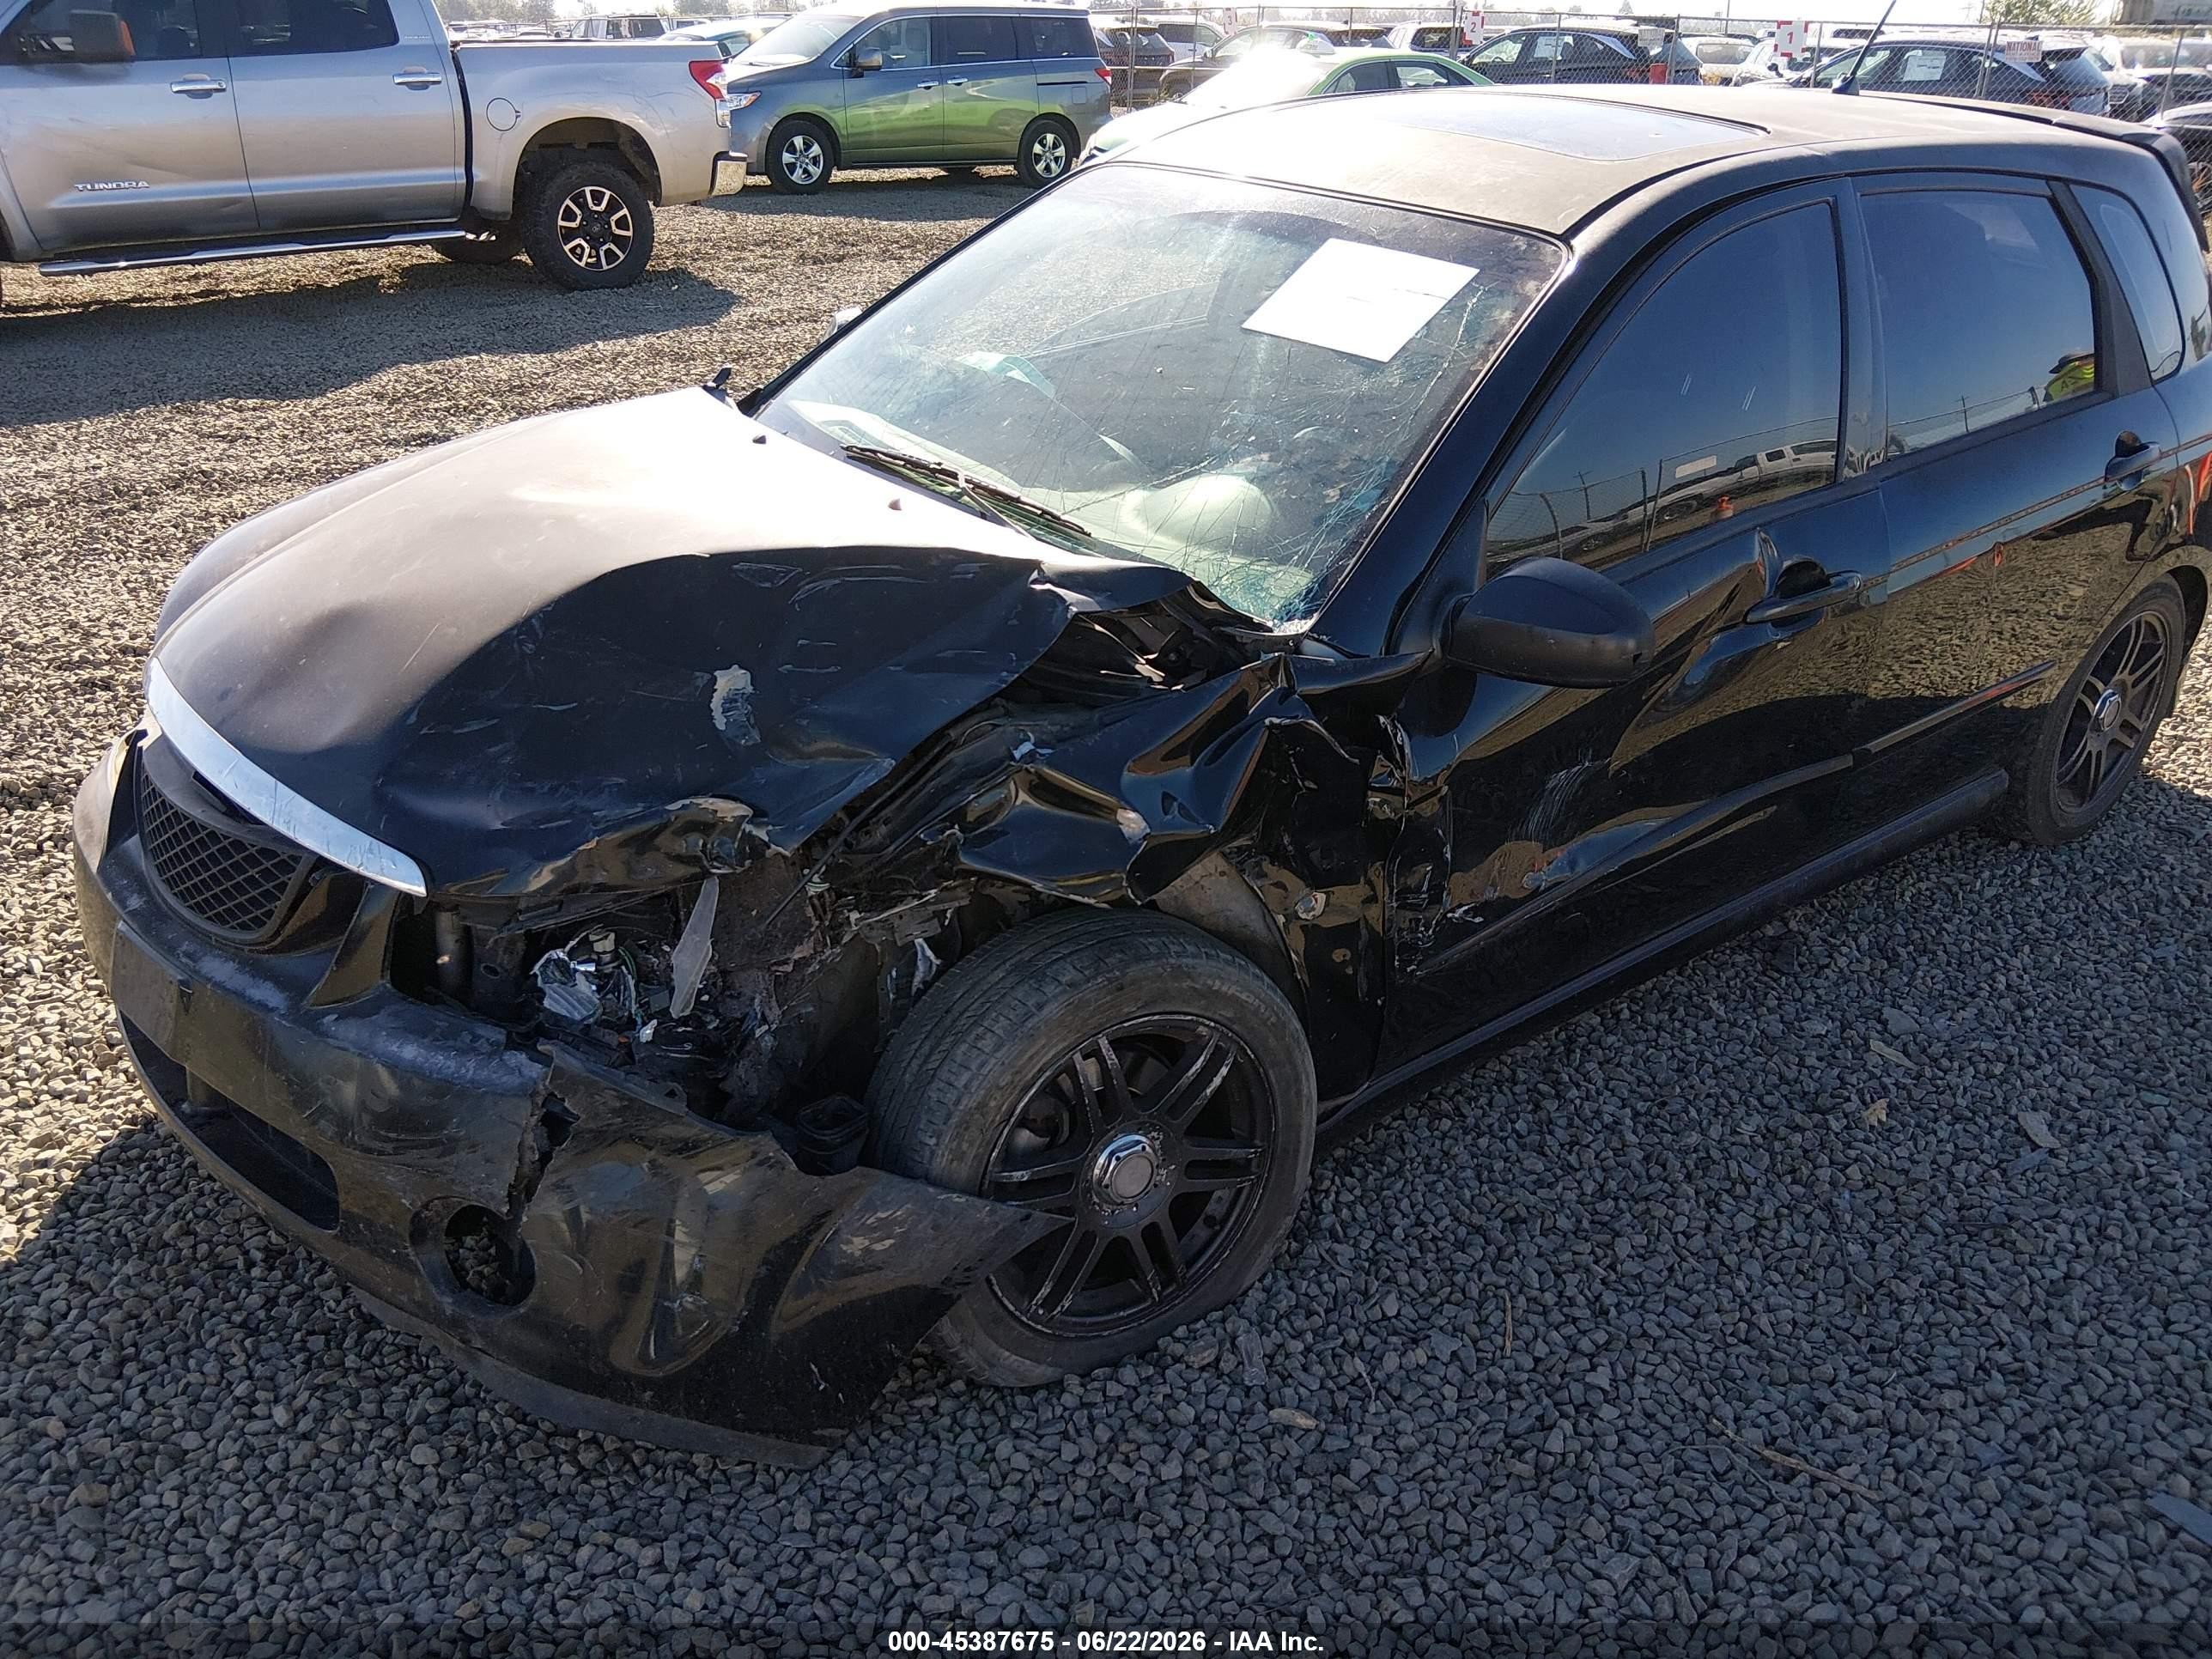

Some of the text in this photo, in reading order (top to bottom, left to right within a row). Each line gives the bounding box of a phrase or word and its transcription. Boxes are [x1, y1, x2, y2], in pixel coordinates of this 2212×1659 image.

[1228, 15, 1233, 26] 3
[1470, 21, 1477, 33] 2
[1787, 31, 1794, 44] 1
[74, 180, 150, 191] TUNDRA
